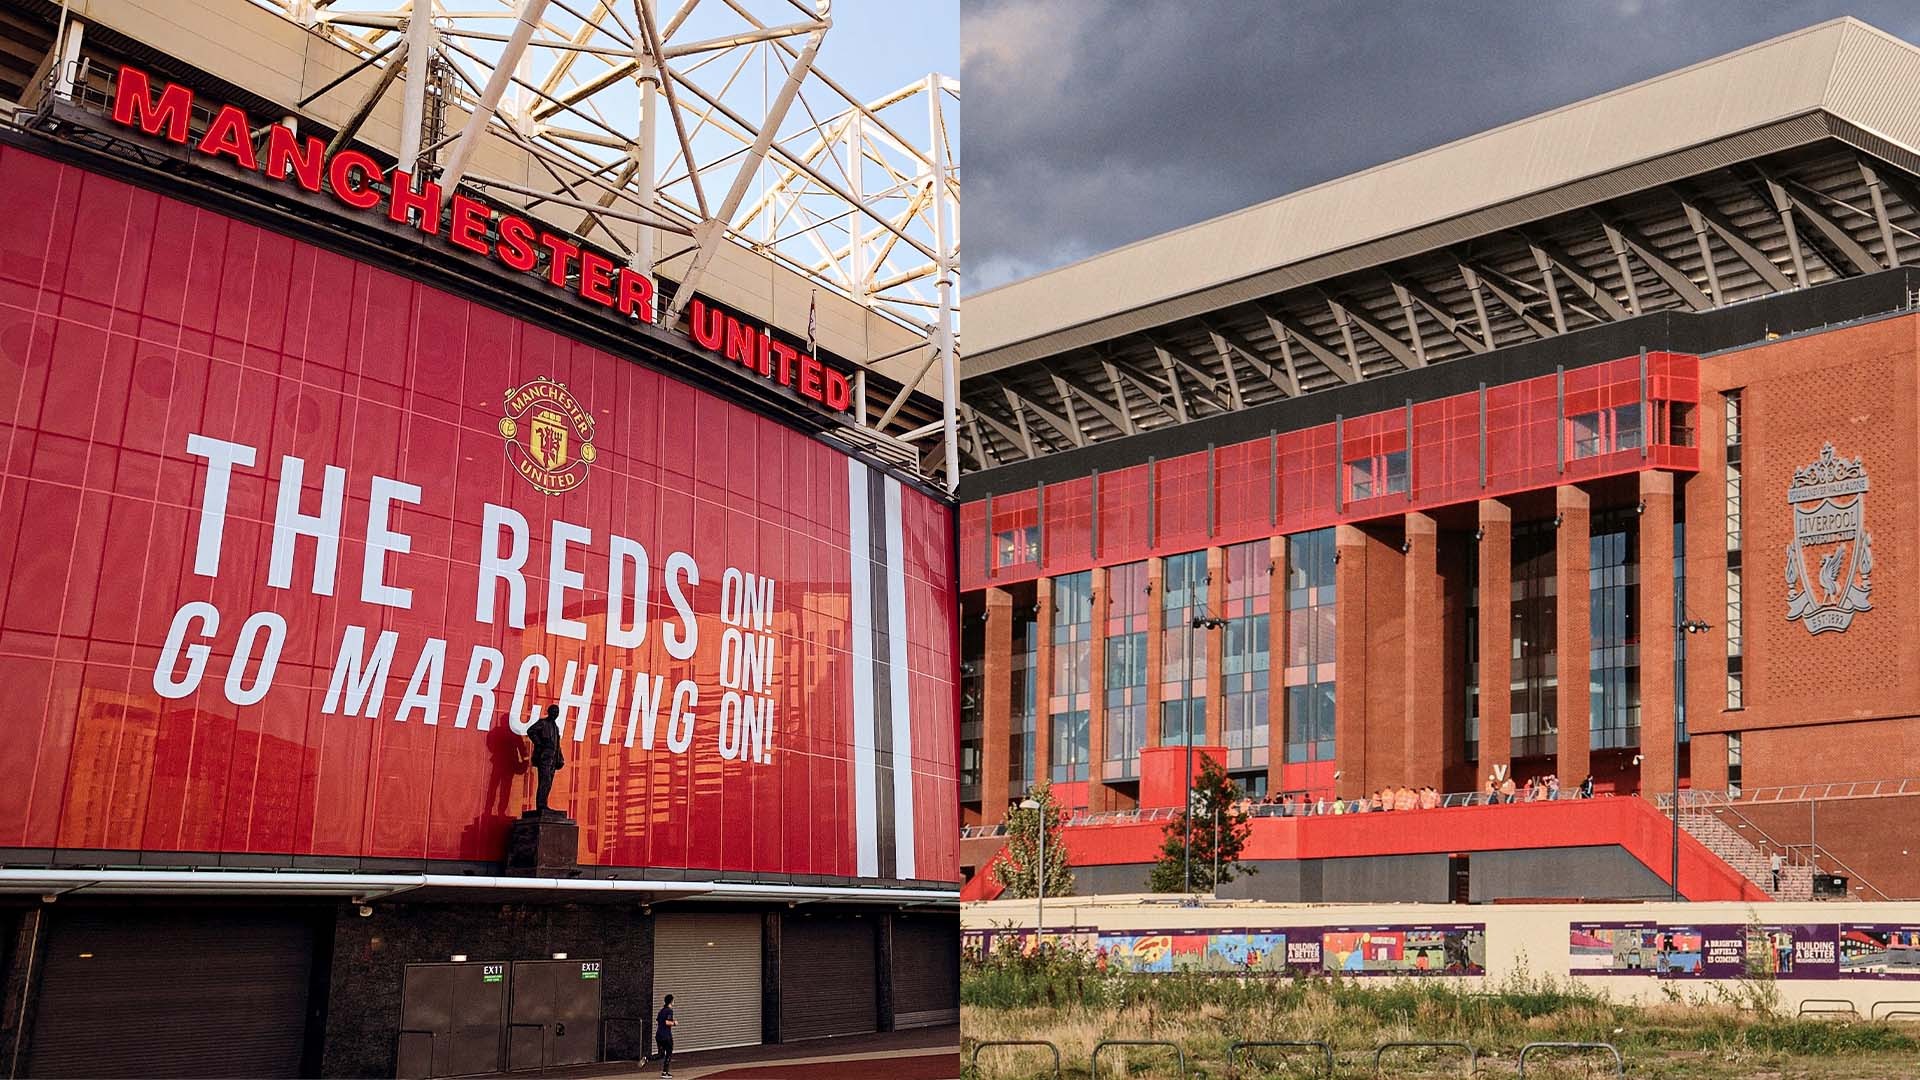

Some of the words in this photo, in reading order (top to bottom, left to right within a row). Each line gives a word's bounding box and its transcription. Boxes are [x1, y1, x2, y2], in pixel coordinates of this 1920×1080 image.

[112, 64, 654, 324] MANCHESTER
[689, 300, 850, 411] UNITED
[512, 385, 587, 434] MANCHESTER
[520, 459, 575, 487] UNITED
[1799, 511, 1857, 534] LIVERPOOL
[186, 433, 422, 609] THE
[476, 502, 700, 660] REDS
[720, 567, 775, 634] ON!
[719, 627, 775, 695] ON!
[152, 601, 288, 706] GO
[321, 624, 699, 755] MARCHING
[718, 691, 775, 766] ON!
[1288, 942, 1320, 951] BUILDING
[1295, 950, 1320, 959] BETTER
[1795, 941, 1835, 950] BUILDING
[1795, 950, 1803, 959] A
[1803, 950, 1835, 959] BETTER
[483, 965, 503, 975] EX11
[581, 963, 600, 972] EX12
